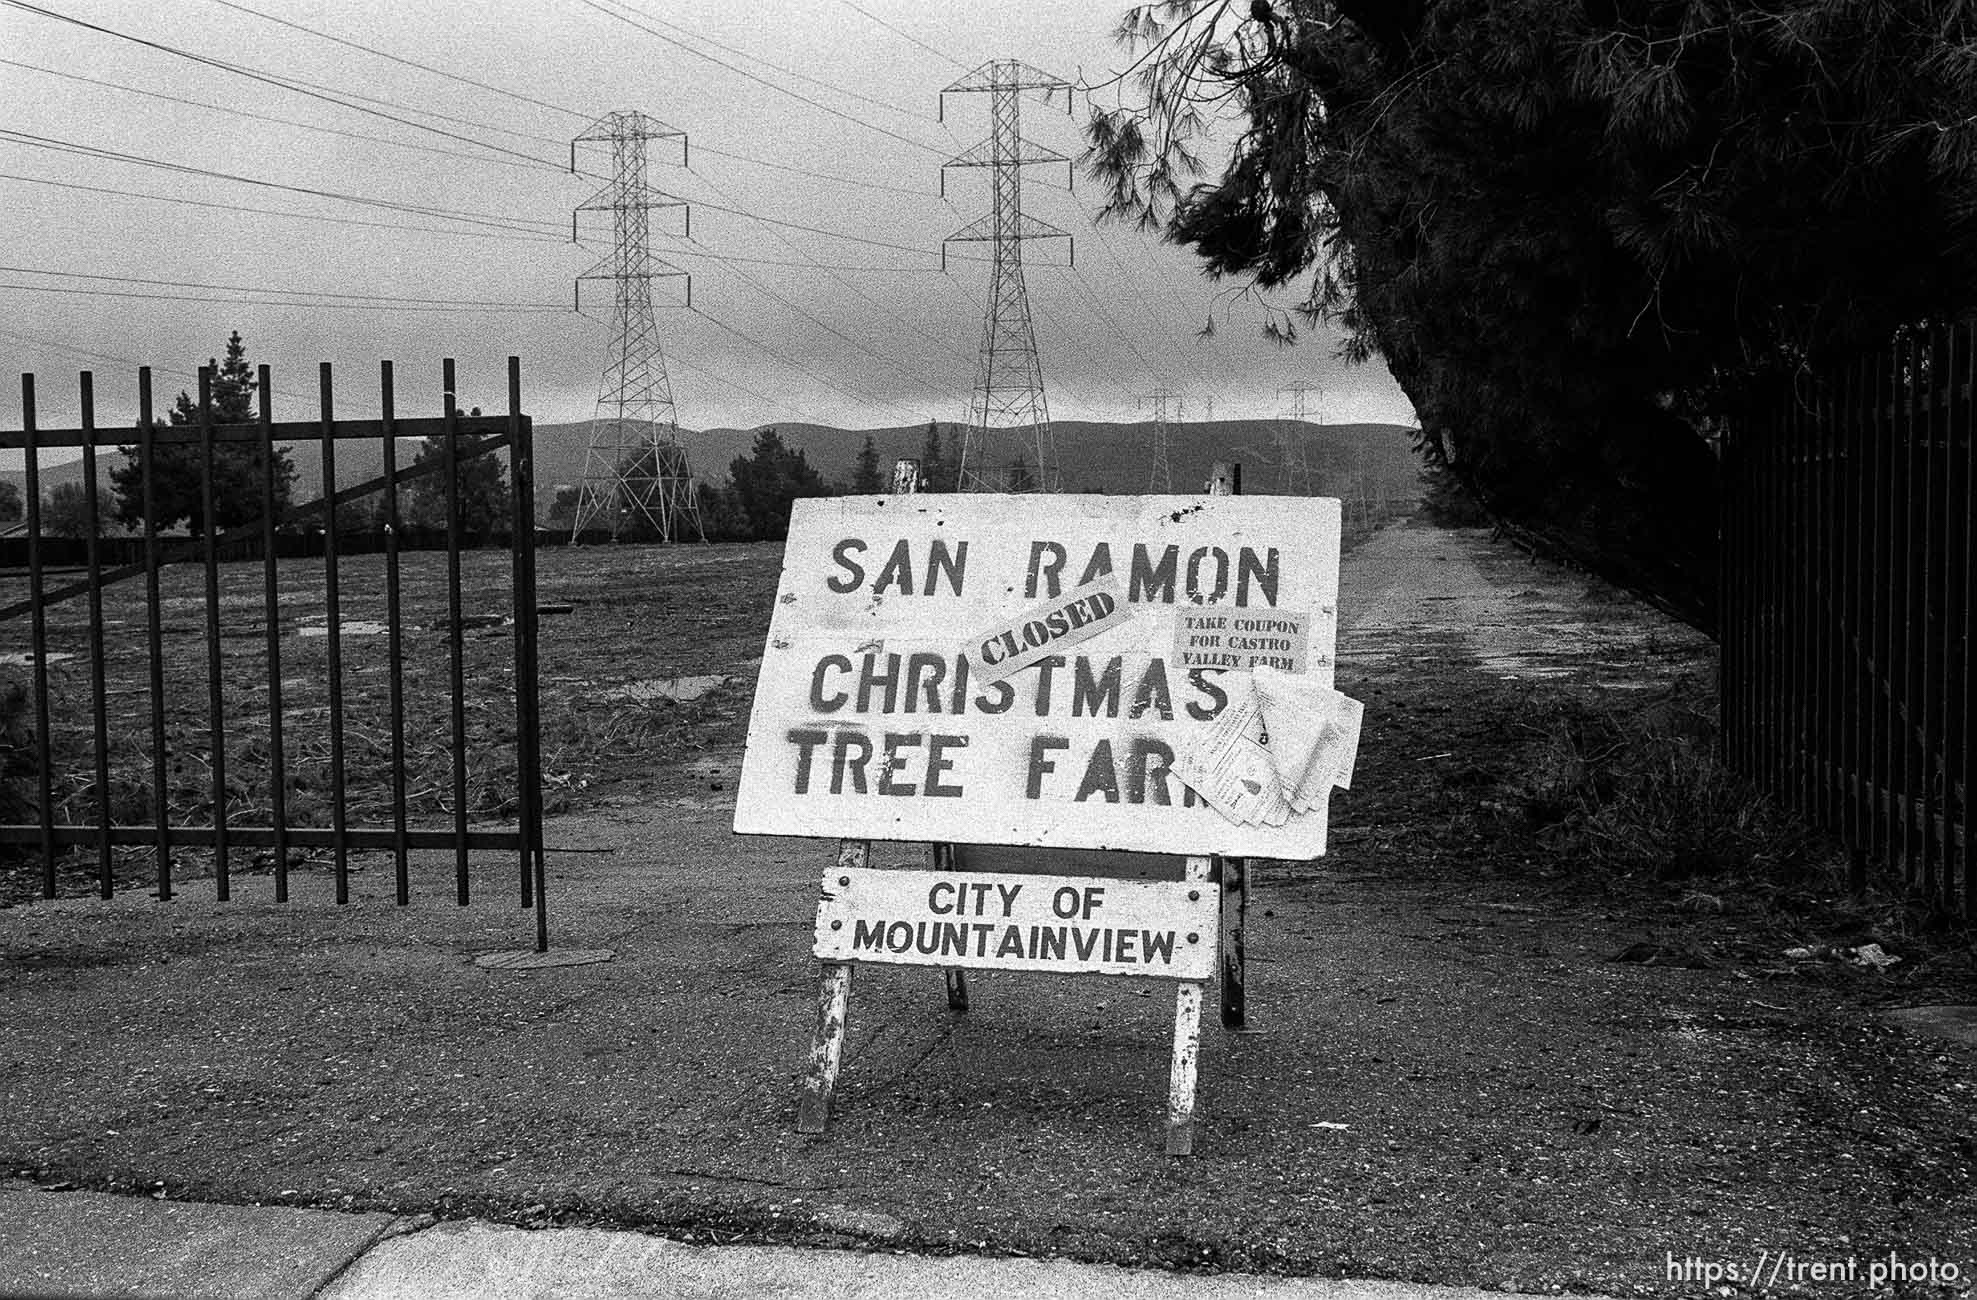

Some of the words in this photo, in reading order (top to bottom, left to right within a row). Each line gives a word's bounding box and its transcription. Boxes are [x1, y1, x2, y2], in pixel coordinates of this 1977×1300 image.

[827, 538, 969, 597] SAN
[1024, 541, 1280, 607] RAMON
[980, 592, 1115, 665] CLOSED
[1185, 617, 1227, 630] TAKE
[1234, 619, 1300, 634] COUPON
[1190, 635, 1220, 648] FOR
[1228, 637, 1291, 651] CASTRO
[1182, 652, 1242, 667] VALLEY
[1250, 656, 1294, 671] FARM
[810, 653, 1229, 721] CHRISTMAS
[788, 729, 969, 797] TREE
[1024, 735, 1210, 808] FAR
[928, 881, 1023, 917] CITY
[1052, 886, 1105, 920] OF
[852, 919, 1176, 965] MOUNTAINVIEW
